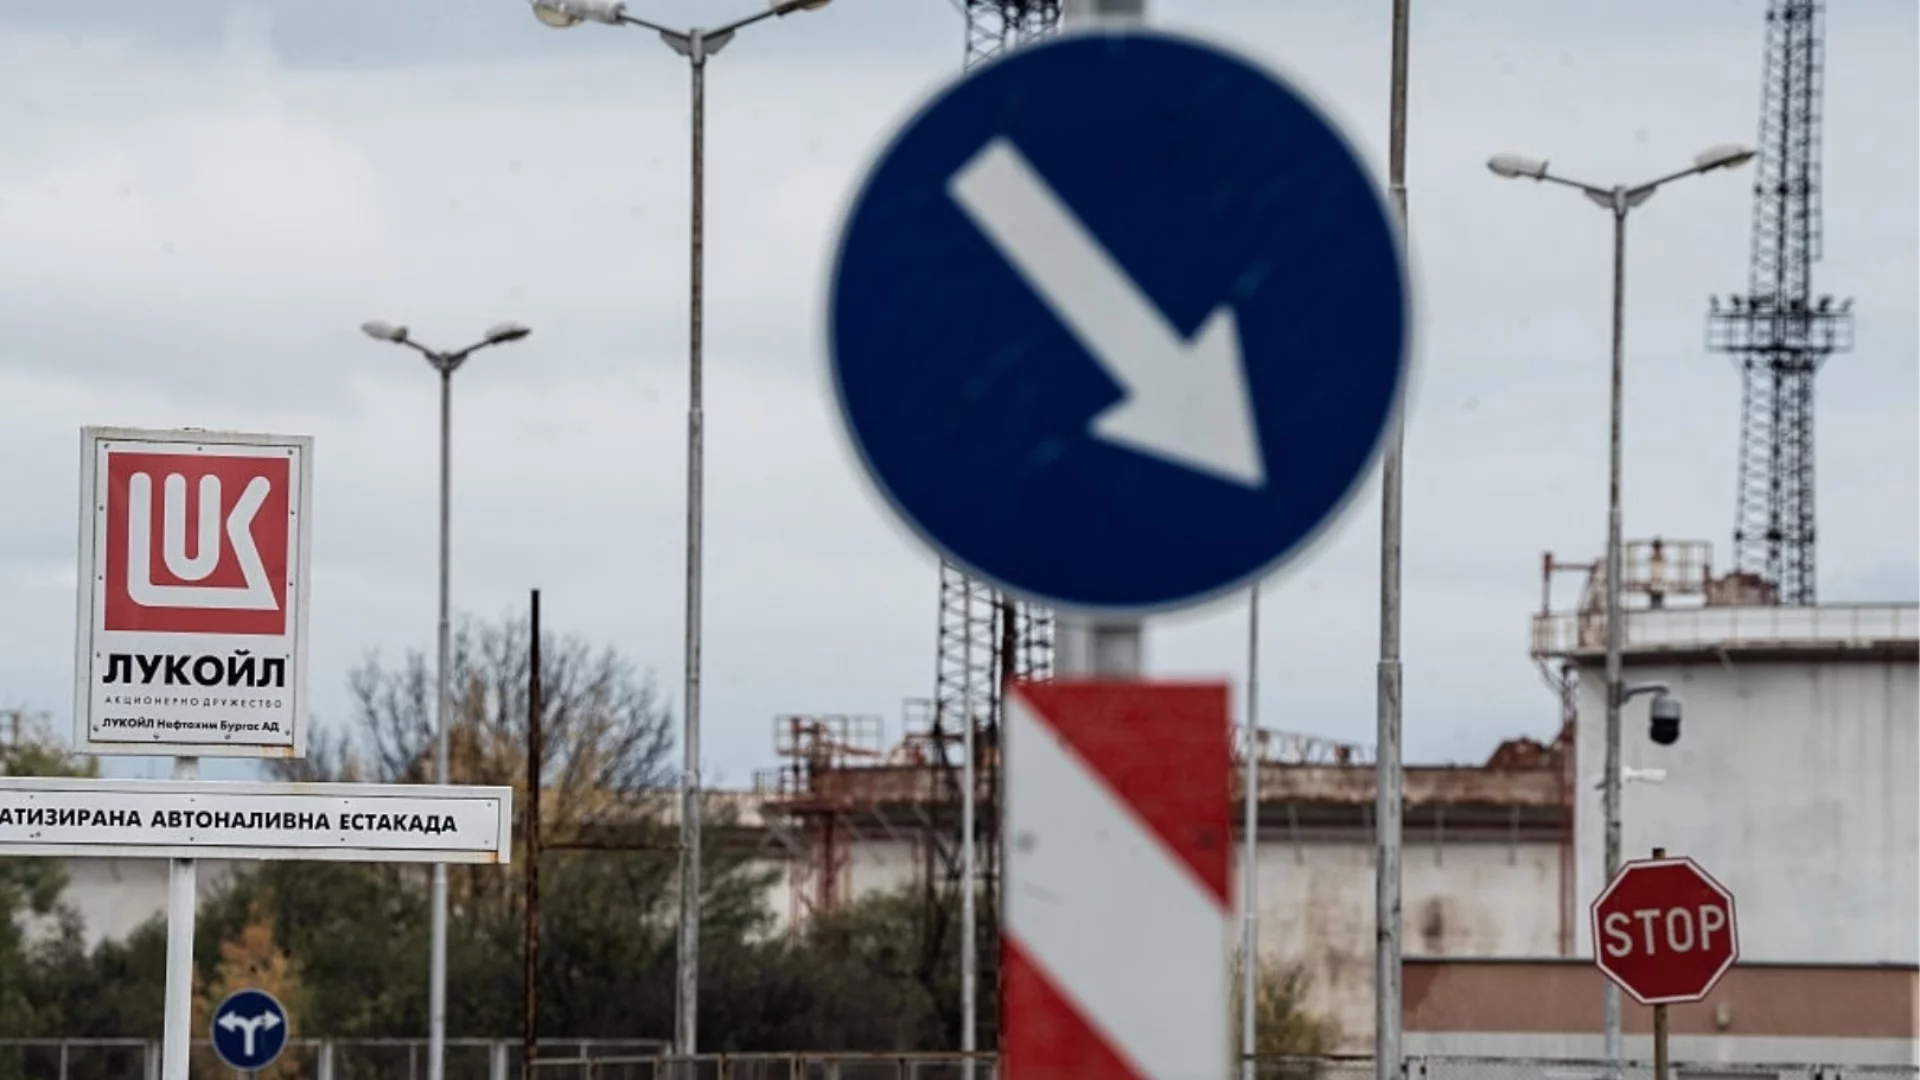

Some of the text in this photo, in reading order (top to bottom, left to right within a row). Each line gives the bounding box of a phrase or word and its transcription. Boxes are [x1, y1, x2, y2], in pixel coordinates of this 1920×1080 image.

[102, 649, 285, 687] ЛУКОЙЛ
[105, 695, 282, 708] АКЦИОНЕРНО ДРУЖЕСТВО
[102, 717, 280, 732] ЛУКОЙЛ Нефтохим Бургас АД
[151, 810, 330, 831] АВТОНАЛИВНА
[340, 813, 457, 834] ЕСТАКАДА
[1604, 905, 1725, 958] STOP
